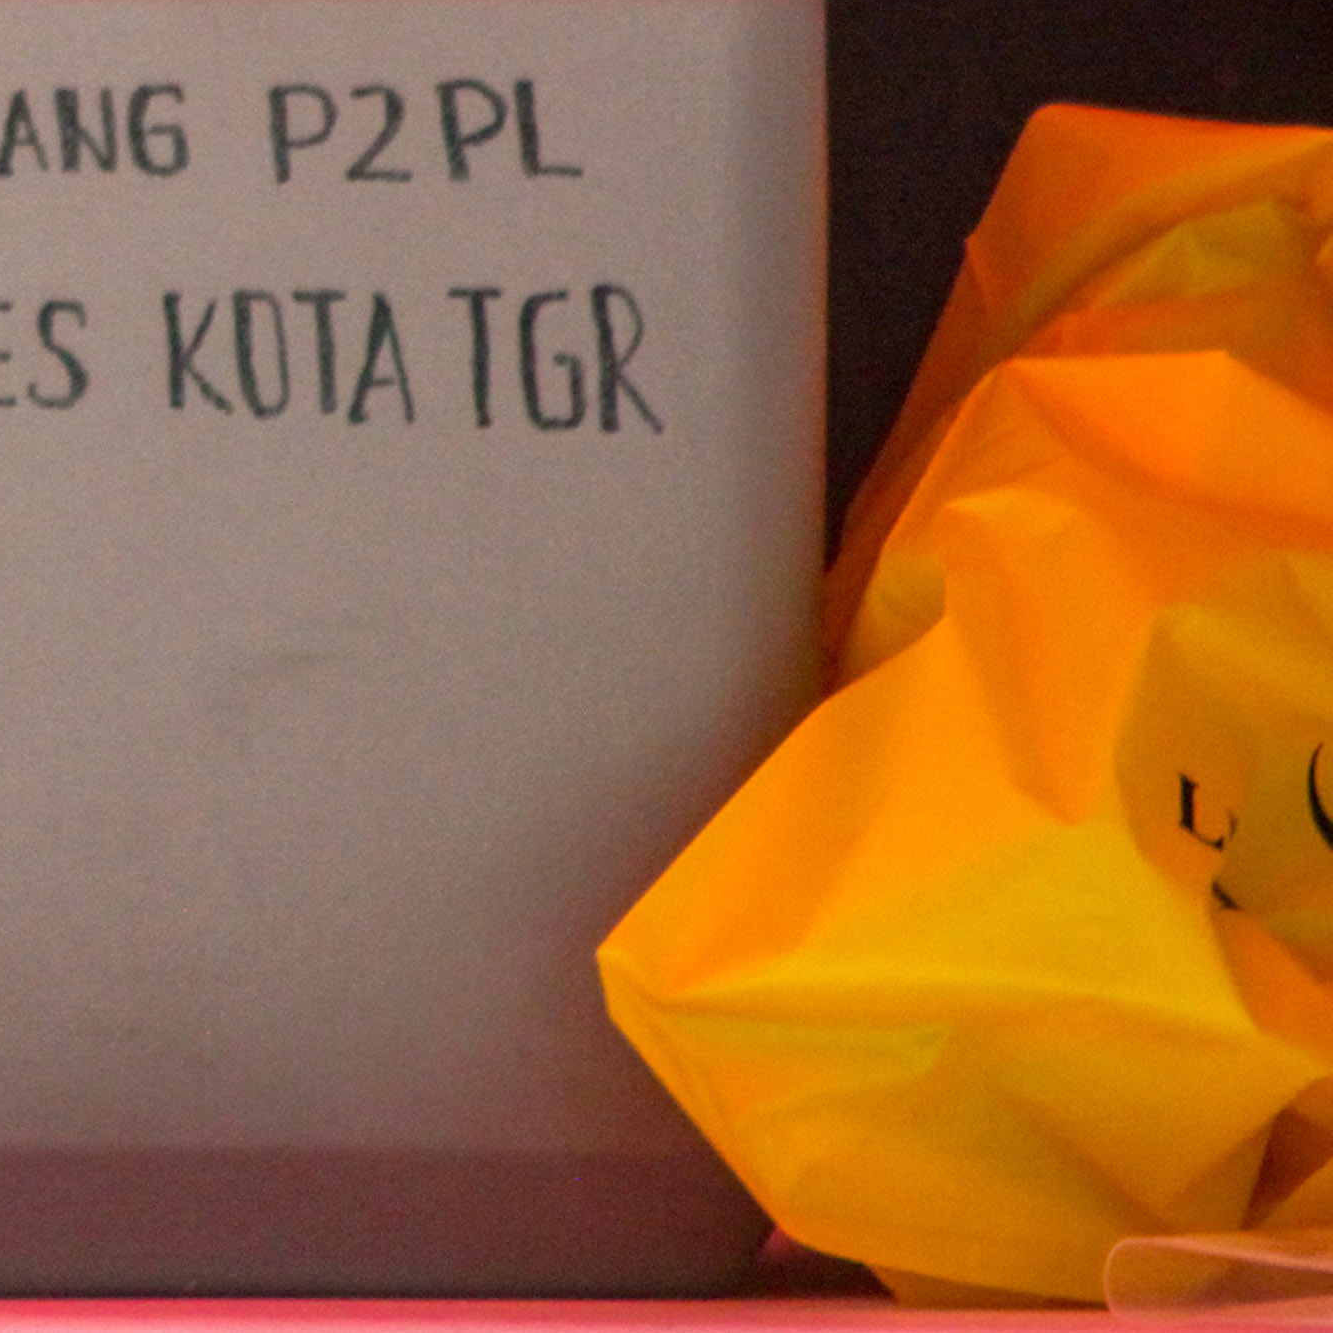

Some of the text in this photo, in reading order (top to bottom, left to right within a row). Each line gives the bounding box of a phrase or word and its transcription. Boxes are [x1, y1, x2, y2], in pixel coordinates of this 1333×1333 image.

[267, 78, 583, 184] P2PL
[161, 288, 415, 426] KOTA
[447, 283, 662, 434] TGR
